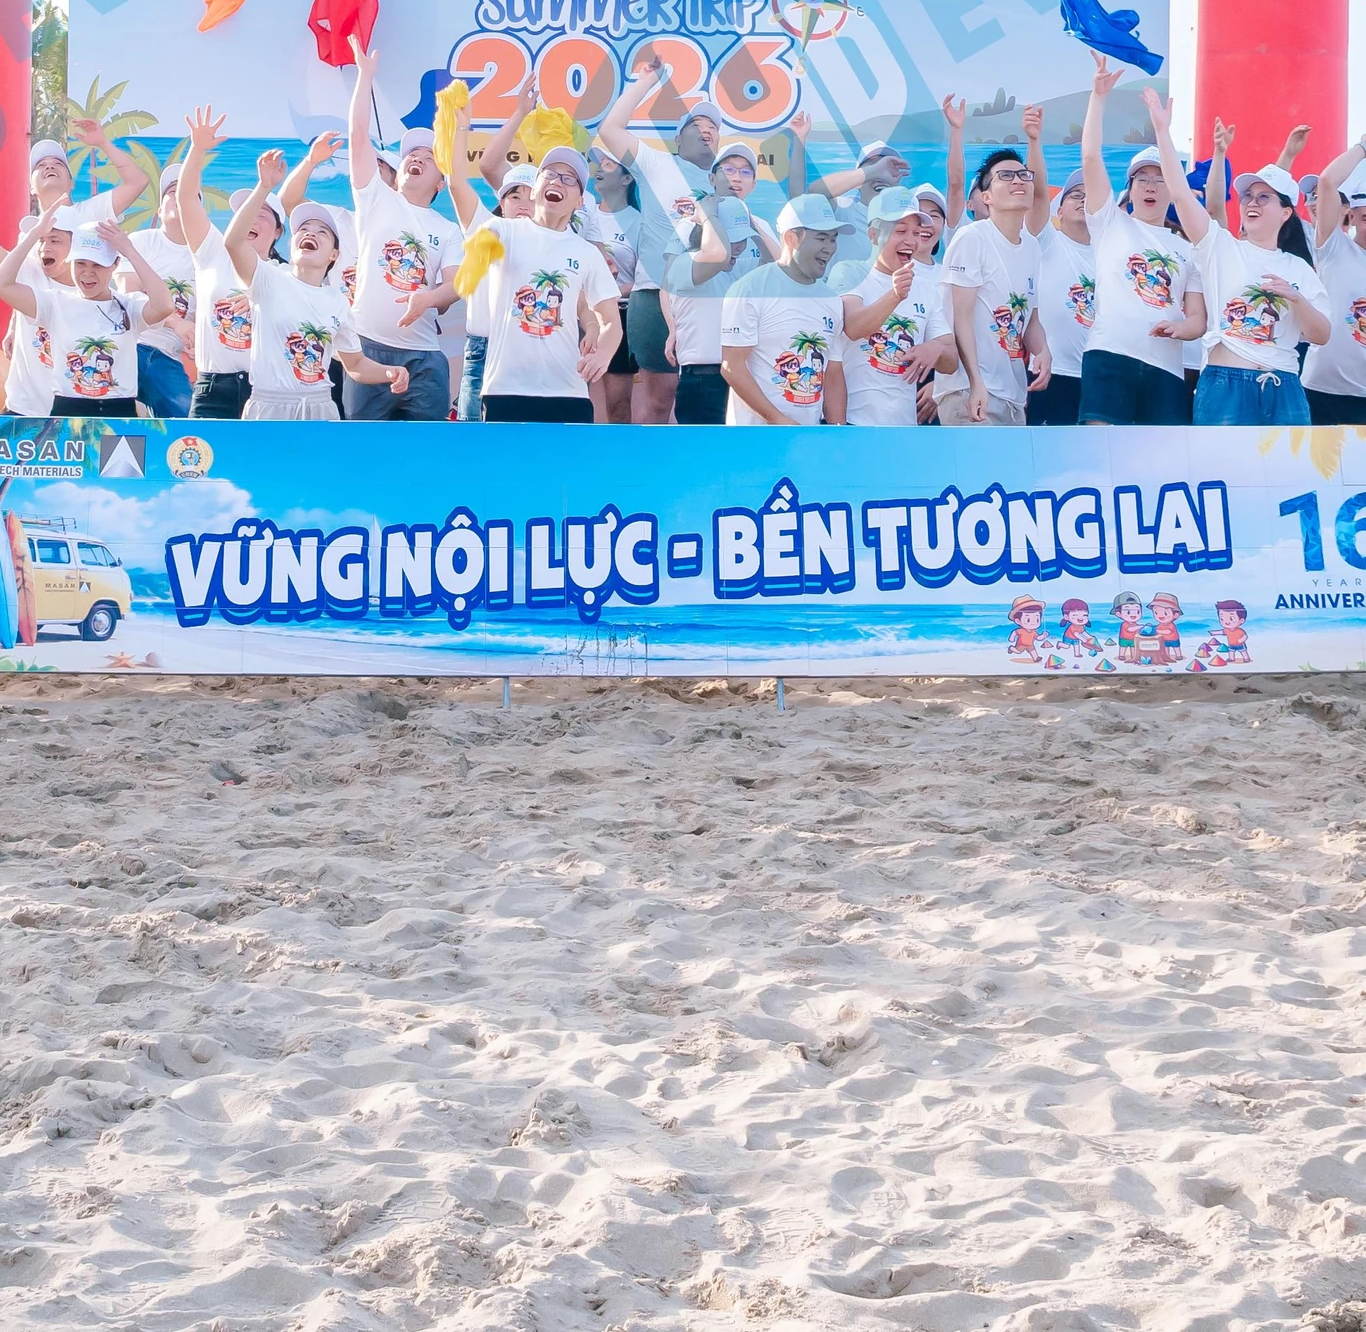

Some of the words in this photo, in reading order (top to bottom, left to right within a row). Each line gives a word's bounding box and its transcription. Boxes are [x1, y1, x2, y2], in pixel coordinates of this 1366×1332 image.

[452, 37, 794, 125] 2026
[467, 148, 520, 162] VG
[82, 239, 101, 247] 2026
[428, 234, 439, 246] 16
[614, 233, 625, 242] 16
[750, 248, 760, 258] 16
[567, 258, 579, 270] 16
[913, 303, 925, 314] 16
[823, 317, 833, 329] 16
[22, 466, 83, 478] MATERIALS
[168, 522, 367, 614] VỮNG
[383, 511, 510, 617] NỘI
[529, 509, 655, 611] LỰC
[716, 481, 850, 587] BỀN
[865, 488, 1103, 575] TƯƠNG
[1117, 484, 1231, 562] LAI
